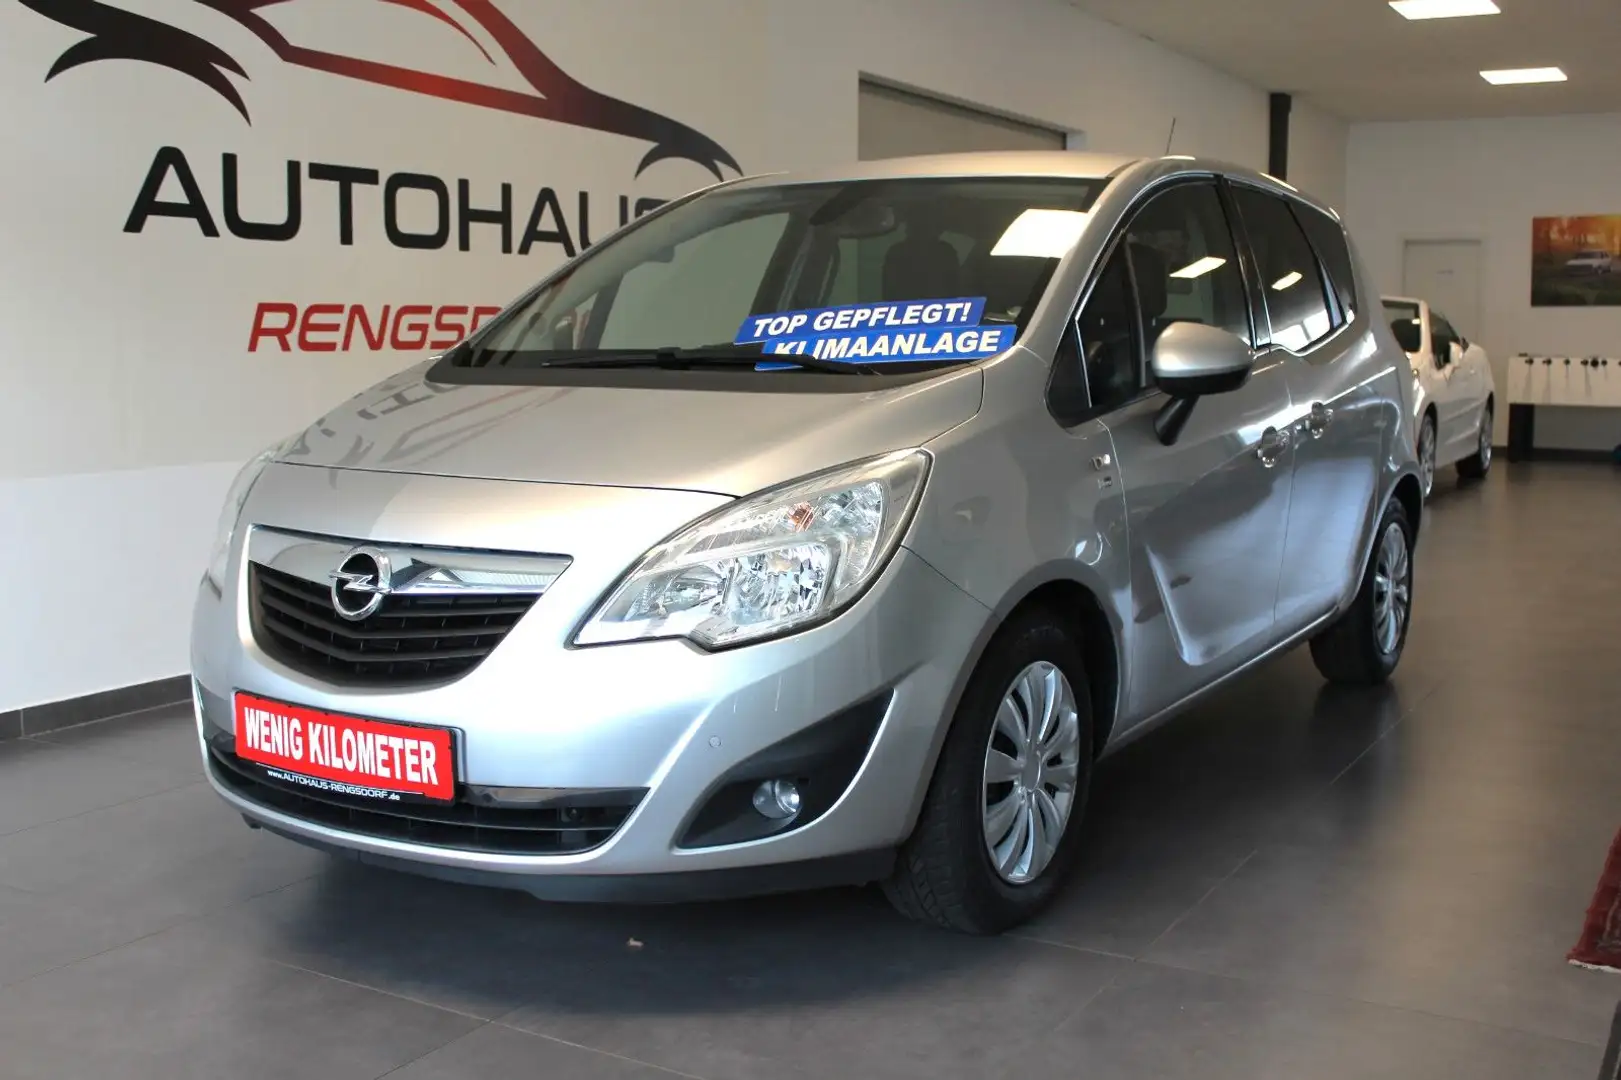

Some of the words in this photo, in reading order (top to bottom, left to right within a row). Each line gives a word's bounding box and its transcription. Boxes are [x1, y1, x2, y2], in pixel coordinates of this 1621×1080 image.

[753, 314, 808, 337] TOP
[813, 302, 972, 331] GEPFLEGT!
[244, 706, 304, 760] WENIG
[308, 722, 439, 785] KILOMETER
